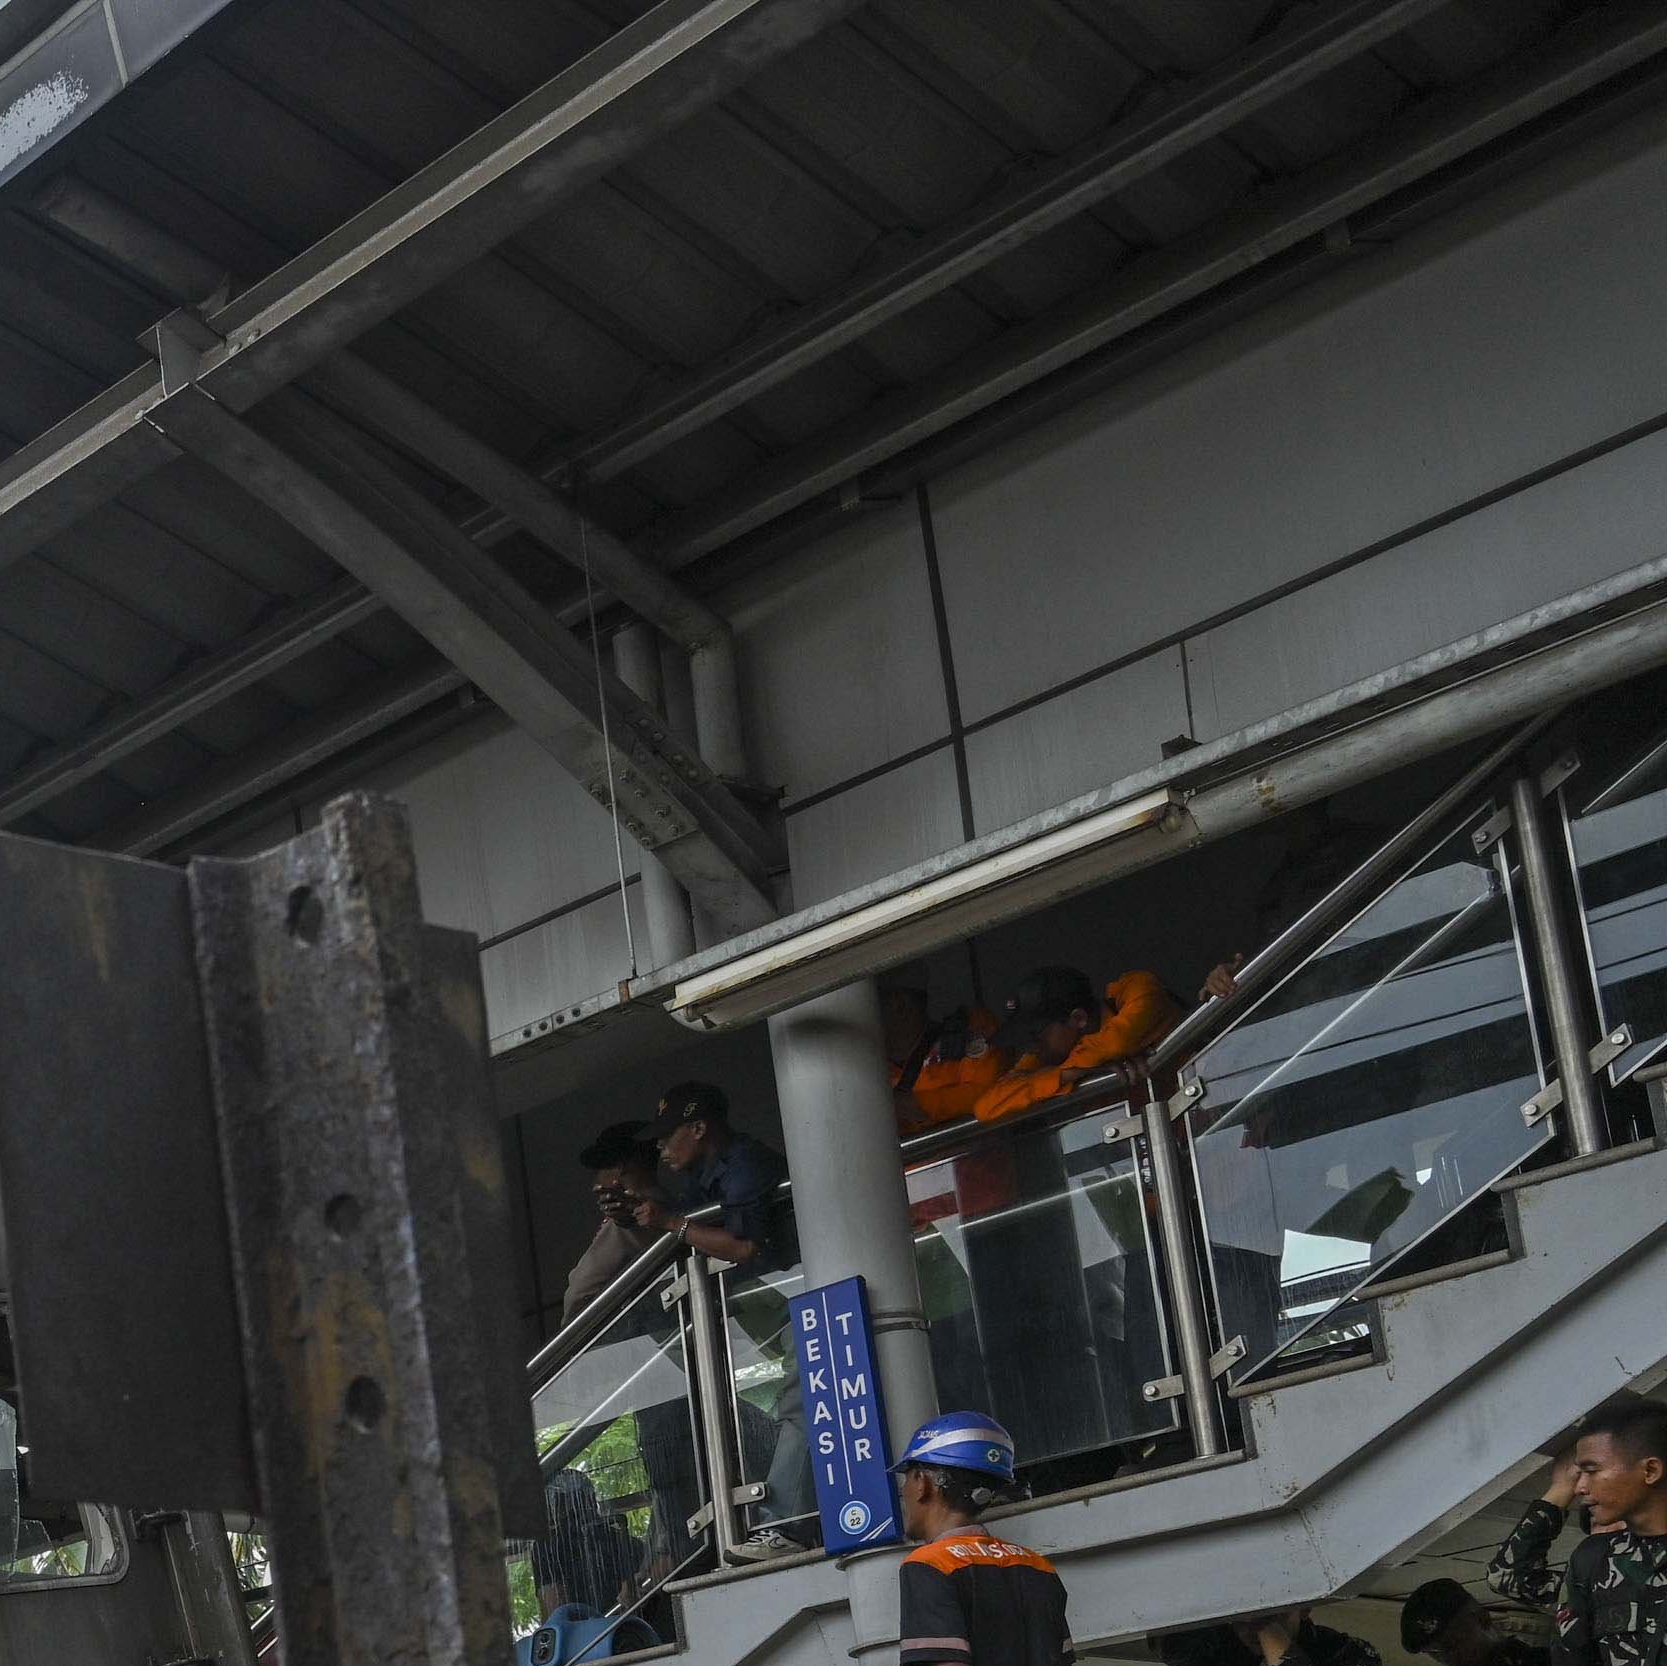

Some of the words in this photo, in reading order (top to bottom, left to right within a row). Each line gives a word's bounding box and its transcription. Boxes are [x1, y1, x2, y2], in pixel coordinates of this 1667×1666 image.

[801, 1308, 835, 1486] BEKASI
[835, 1311, 872, 1462] TIMUR
[849, 1516, 861, 1527] 22
